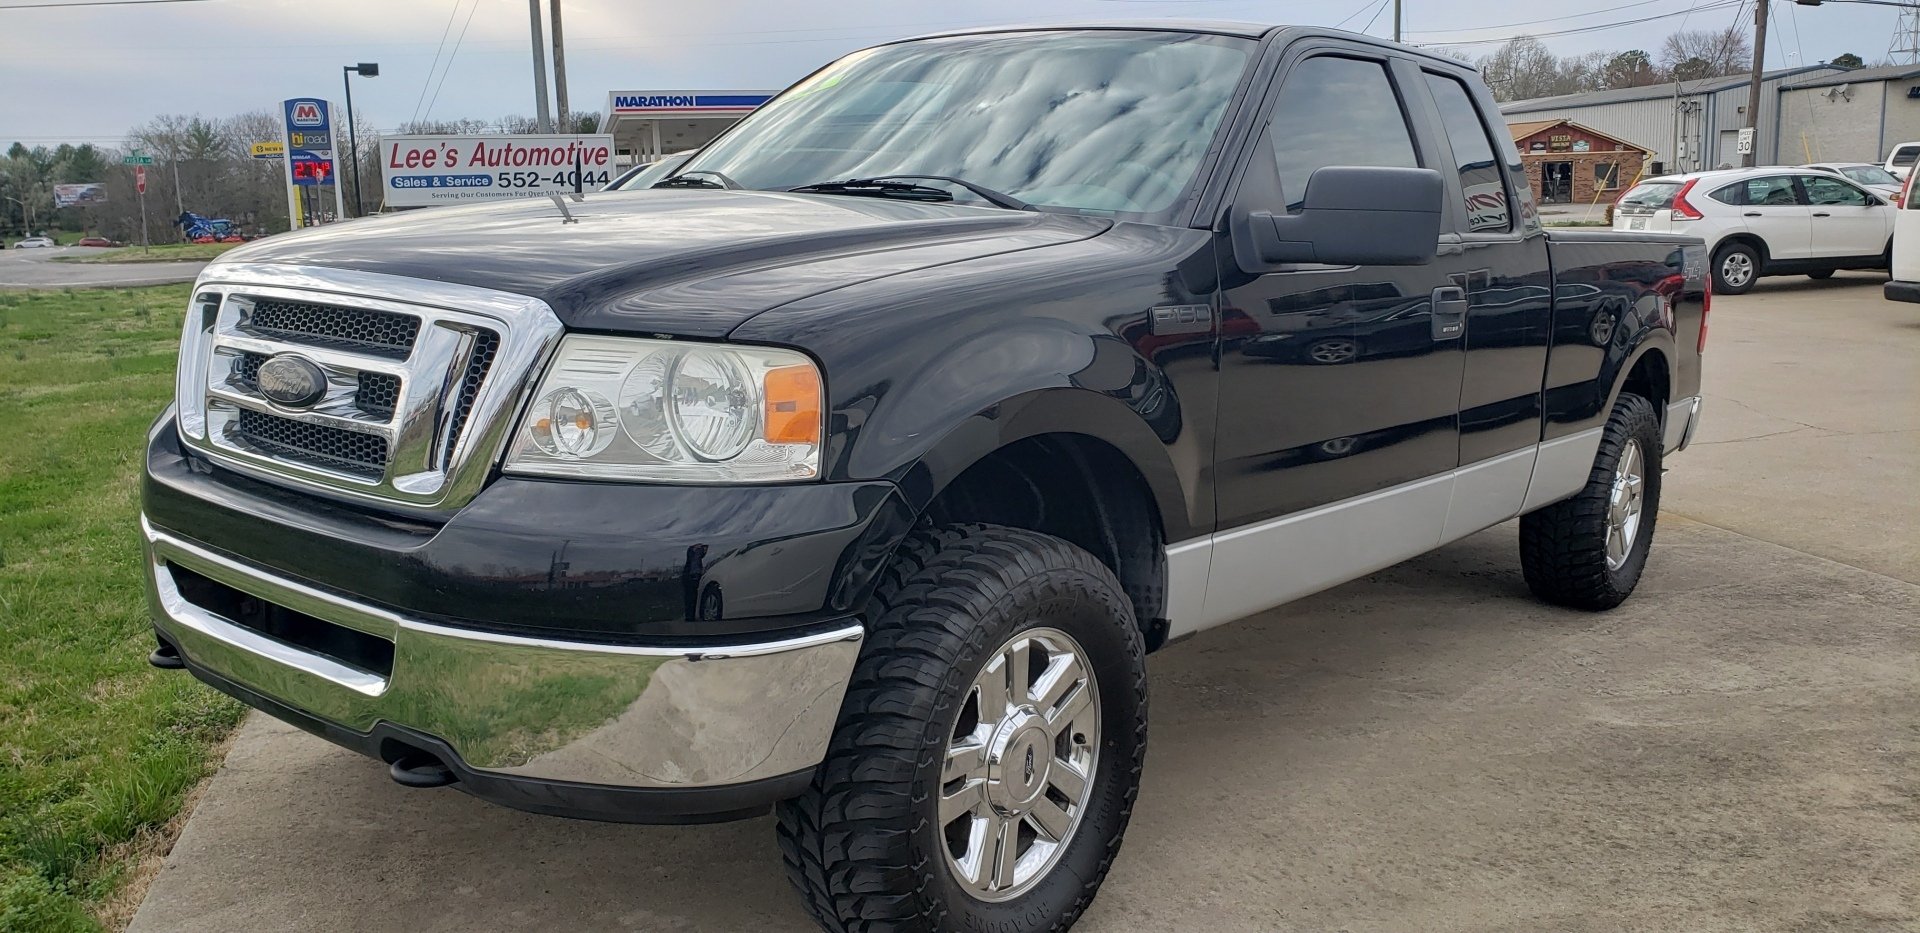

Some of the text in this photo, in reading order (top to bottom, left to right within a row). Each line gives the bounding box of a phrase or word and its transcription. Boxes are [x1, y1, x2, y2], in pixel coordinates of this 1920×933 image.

[615, 95, 693, 107] MARATHON
[297, 106, 317, 117] M
[1738, 141, 1750, 151] 30
[389, 140, 609, 169] Lee's Automotive
[395, 170, 610, 188] Sales & Service 552-4044
[475, 190, 514, 198] Customers
